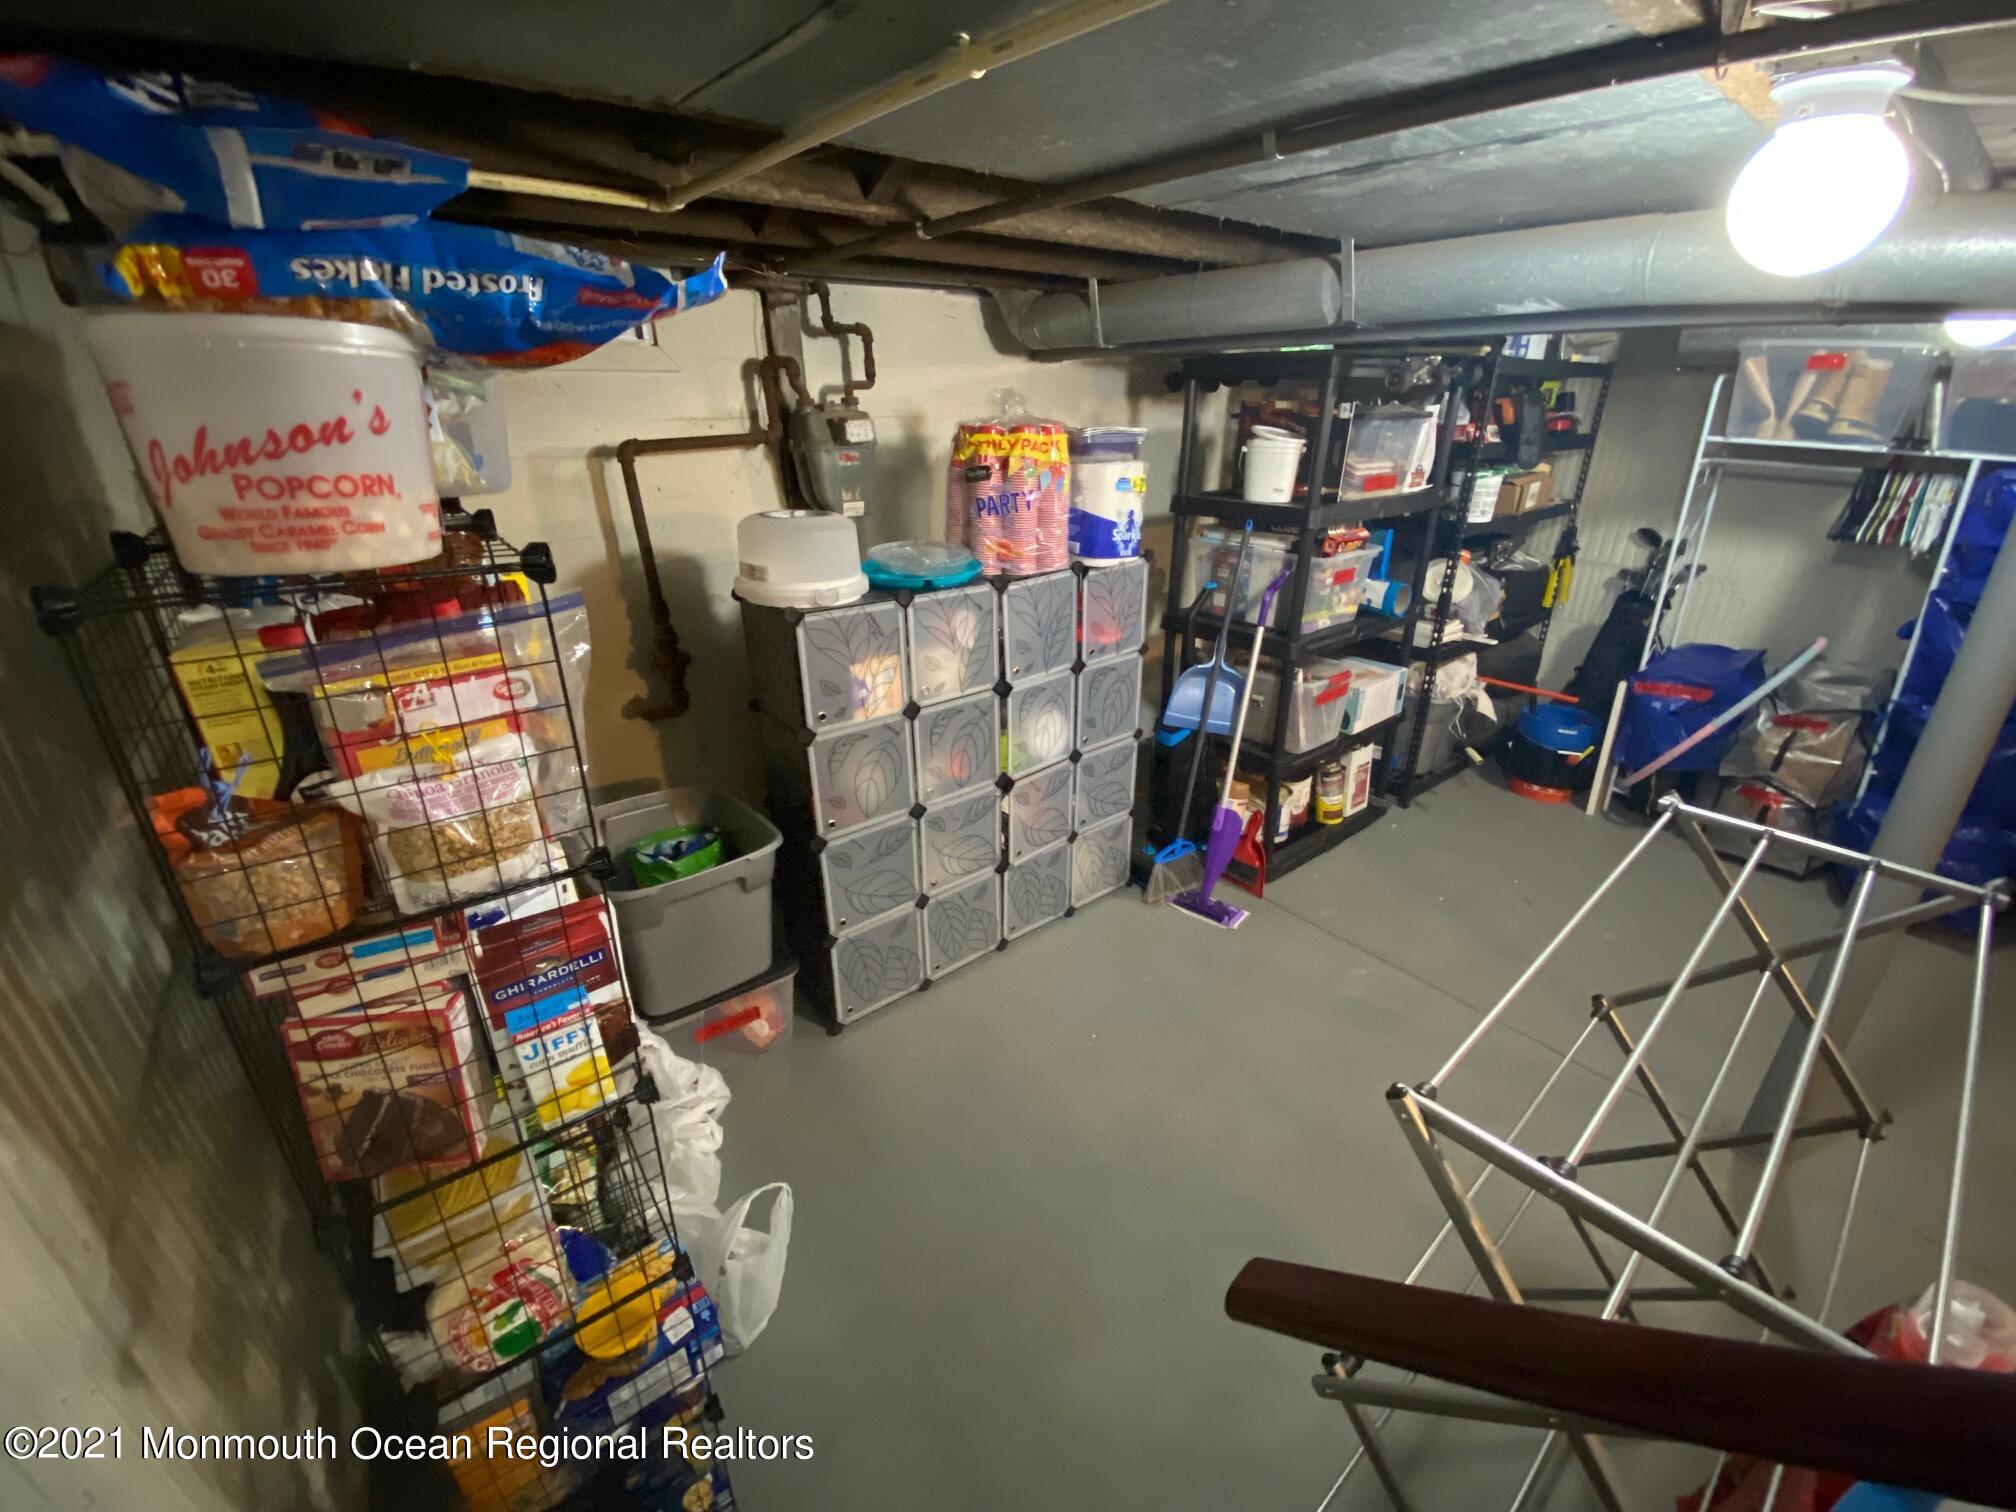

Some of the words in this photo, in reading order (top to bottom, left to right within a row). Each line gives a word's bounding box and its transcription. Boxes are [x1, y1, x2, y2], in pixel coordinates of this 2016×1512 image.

[201, 268, 240, 289] 30
[290, 256, 411, 292] Flakes
[423, 268, 544, 303] Frosted
[149, 388, 392, 508] Johnson's
[976, 490, 1034, 518] PARTY
[494, 951, 603, 1001] GHIRARDELLI
[522, 1023, 593, 1061] JIFFY
